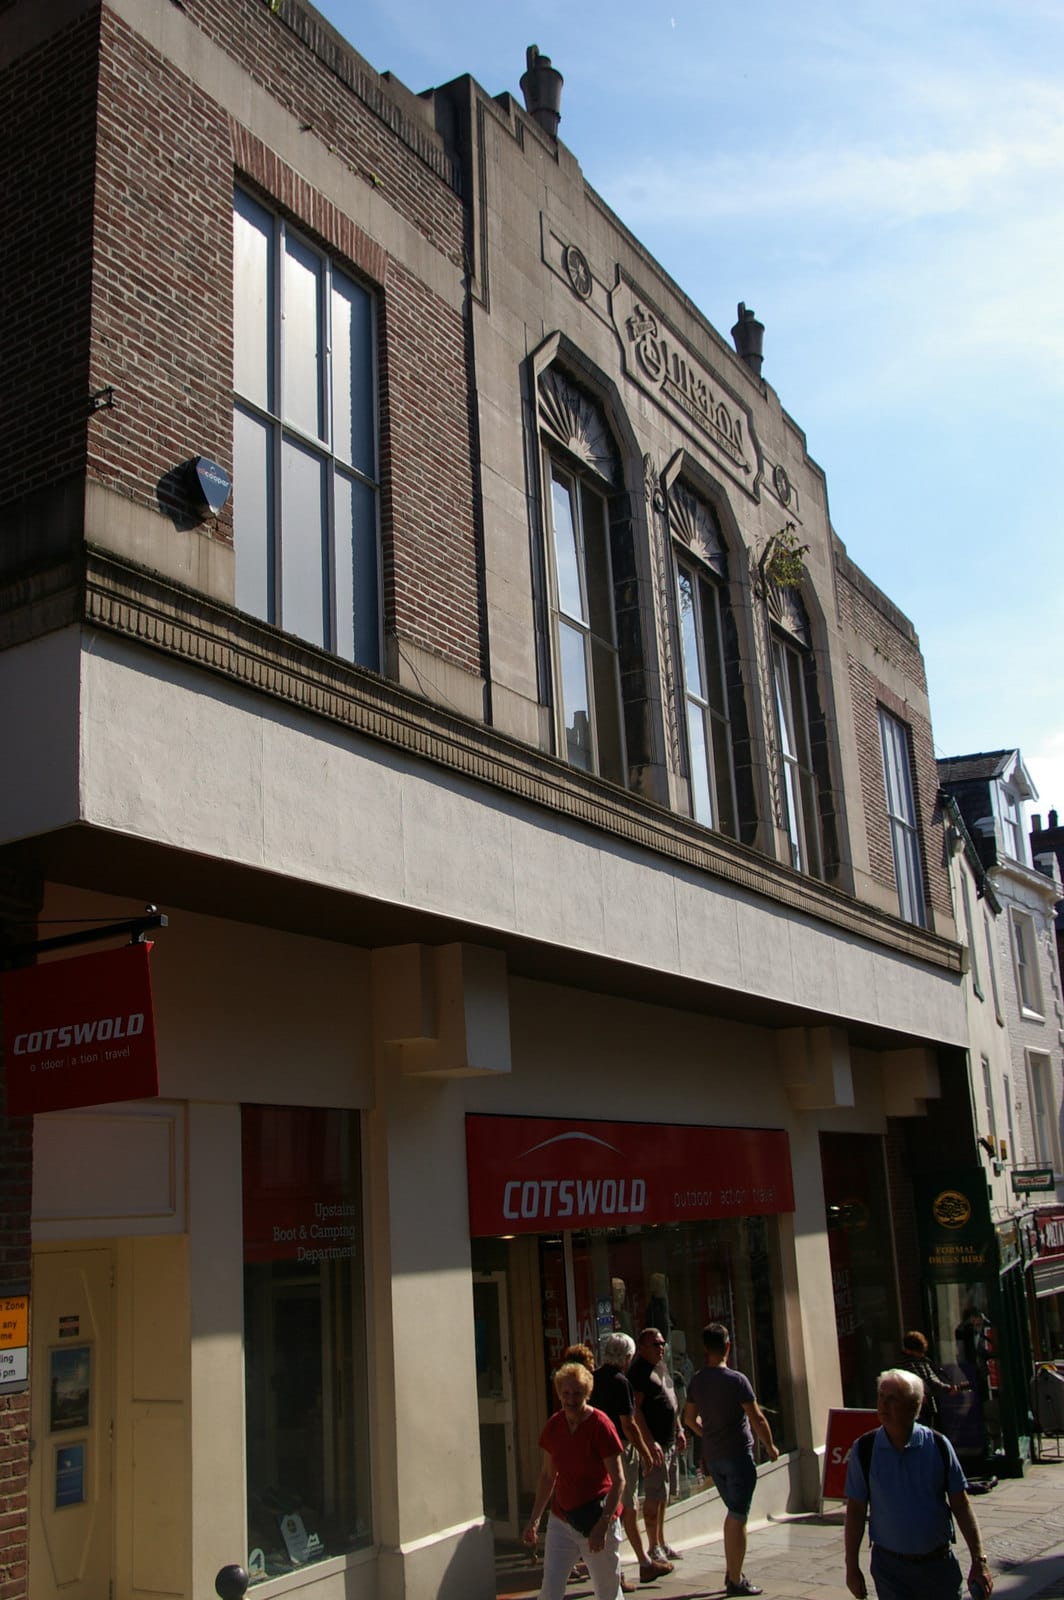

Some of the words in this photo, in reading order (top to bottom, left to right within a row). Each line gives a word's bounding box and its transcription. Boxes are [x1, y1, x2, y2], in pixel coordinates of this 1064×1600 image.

[12, 1012, 146, 1056] COTSWOLD
[30, 1057, 65, 1072] otdoor
[71, 1053, 98, 1065] ation
[105, 1045, 131, 1060] travel
[502, 1178, 647, 1220] COTSWOLD
[313, 1202, 356, 1221] Upstairs
[272, 1225, 297, 1242] Boot
[299, 1224, 308, 1239] &
[310, 1223, 356, 1241] Camping
[296, 1246, 357, 1265] Department
[935, 1245, 976, 1255] FORMAL
[961, 1254, 986, 1264] HIRE
[5, 1301, 25, 1311] Zone
[2, 1319, 17, 1329] any
[0, 1332, 13, 1340] me
